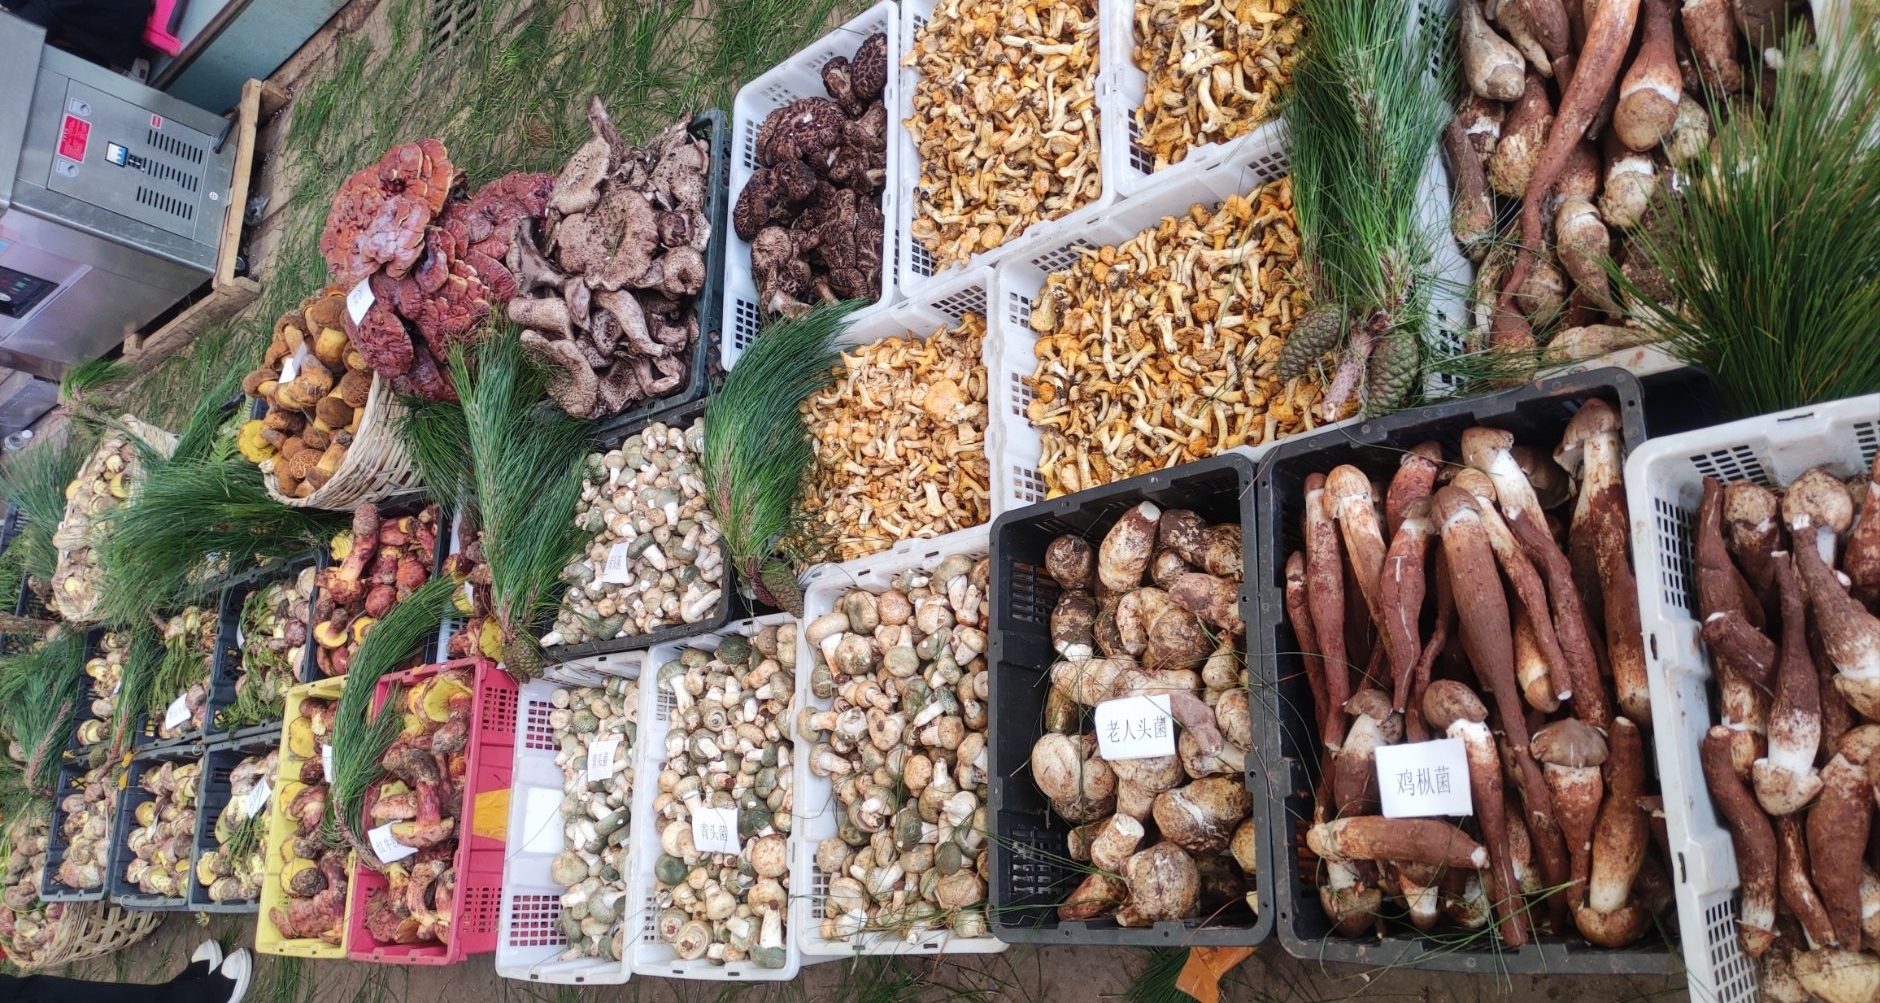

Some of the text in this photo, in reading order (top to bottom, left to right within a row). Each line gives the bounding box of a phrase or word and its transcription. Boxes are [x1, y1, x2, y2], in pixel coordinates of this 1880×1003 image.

[1106, 716, 1167, 743] 老人头菌
[1397, 765, 1451, 796] 鸡枞菌
[700, 822, 728, 842] 青头菌
